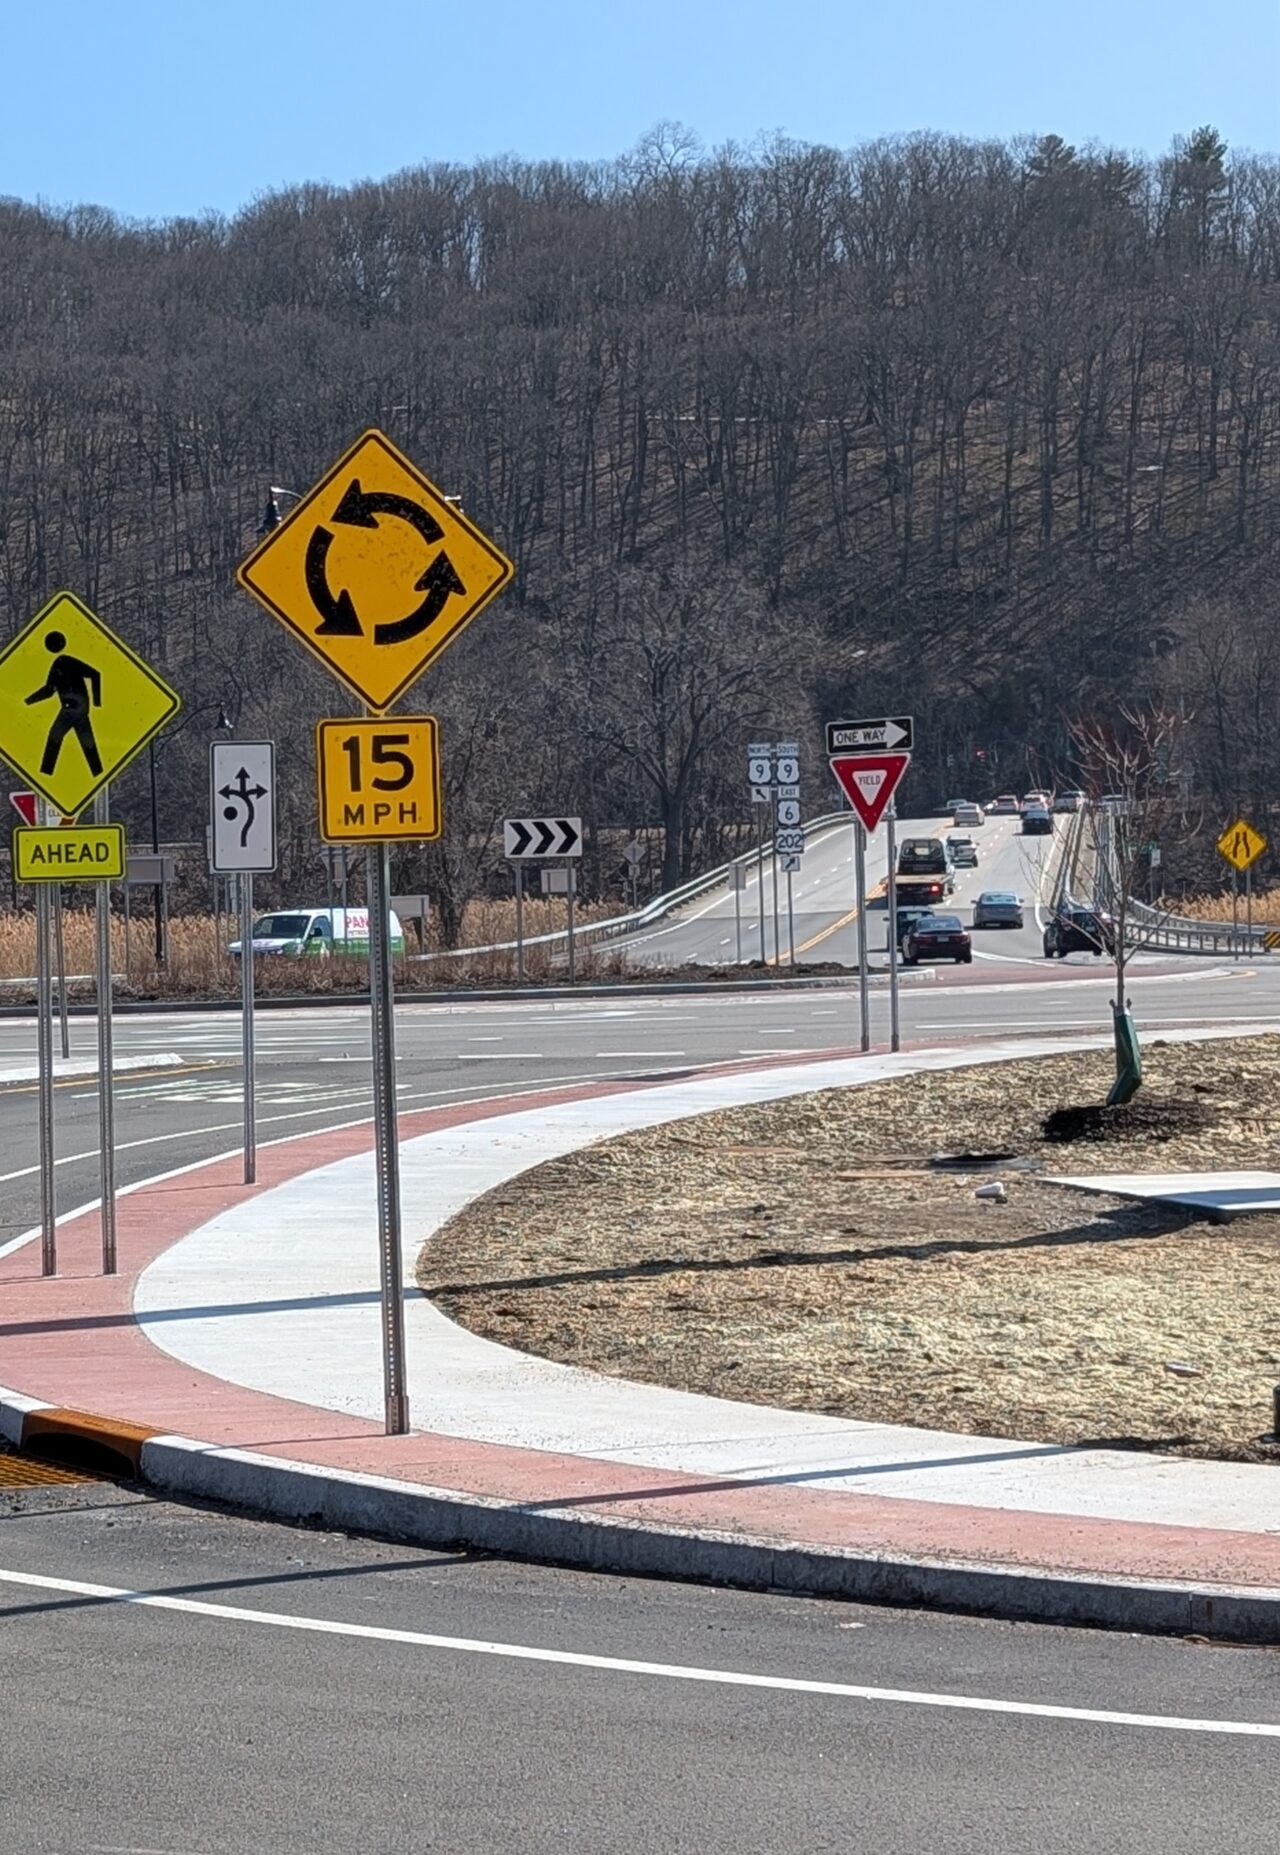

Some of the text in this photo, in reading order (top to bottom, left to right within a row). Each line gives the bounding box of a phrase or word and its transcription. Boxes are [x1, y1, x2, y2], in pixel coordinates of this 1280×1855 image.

[836, 728, 886, 744] ONE WAY
[342, 734, 415, 792] 15
[755, 764, 764, 779] 9
[783, 764, 793, 779] 9
[858, 775, 881, 785] YIELD
[780, 787, 796, 796] EAST
[343, 802, 417, 826] MPH
[785, 806, 794, 820] 6
[778, 834, 803, 848] 202
[30, 842, 110, 864] AHEAD
[345, 916, 370, 929] PAN
